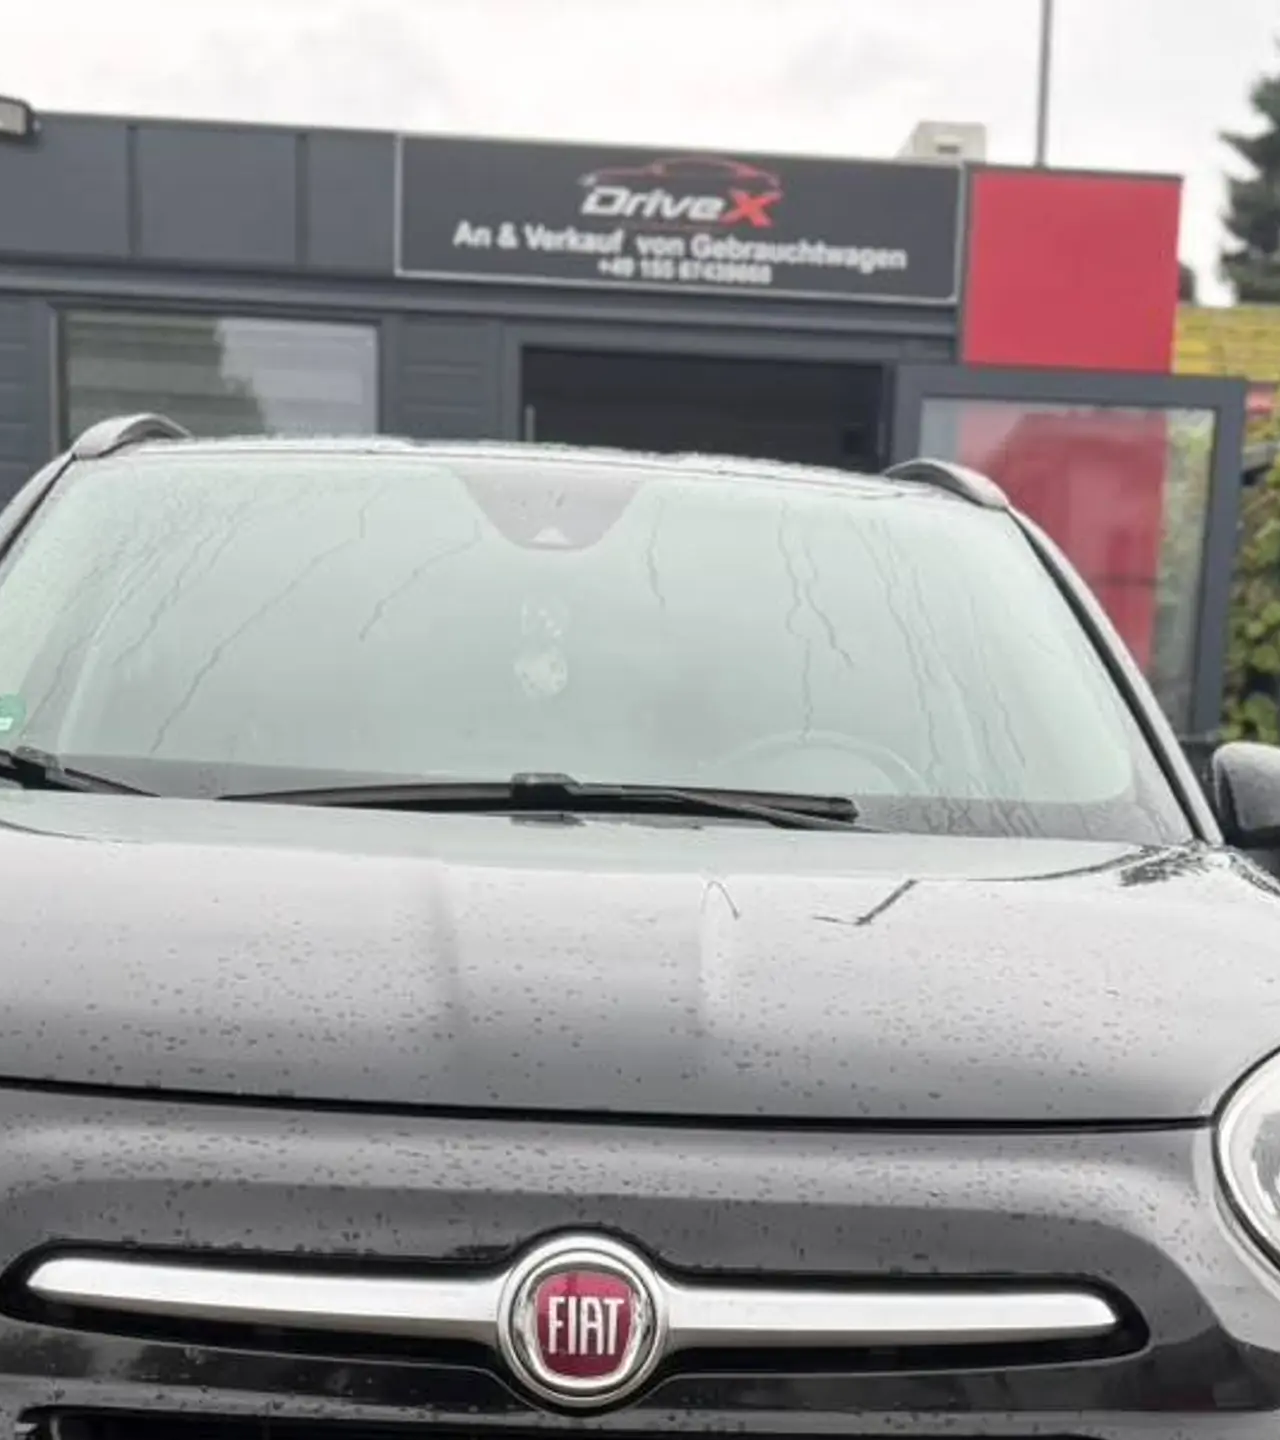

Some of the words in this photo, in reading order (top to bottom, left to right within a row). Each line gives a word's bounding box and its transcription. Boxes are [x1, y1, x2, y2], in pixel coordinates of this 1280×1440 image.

[581, 185, 782, 227] DriveX
[453, 221, 492, 247] An
[497, 223, 518, 249] &
[524, 225, 623, 255] Verkauf
[636, 234, 682, 257] von
[690, 231, 907, 273] Gebrauchtwagen
[548, 1296, 624, 1355] FIAT
